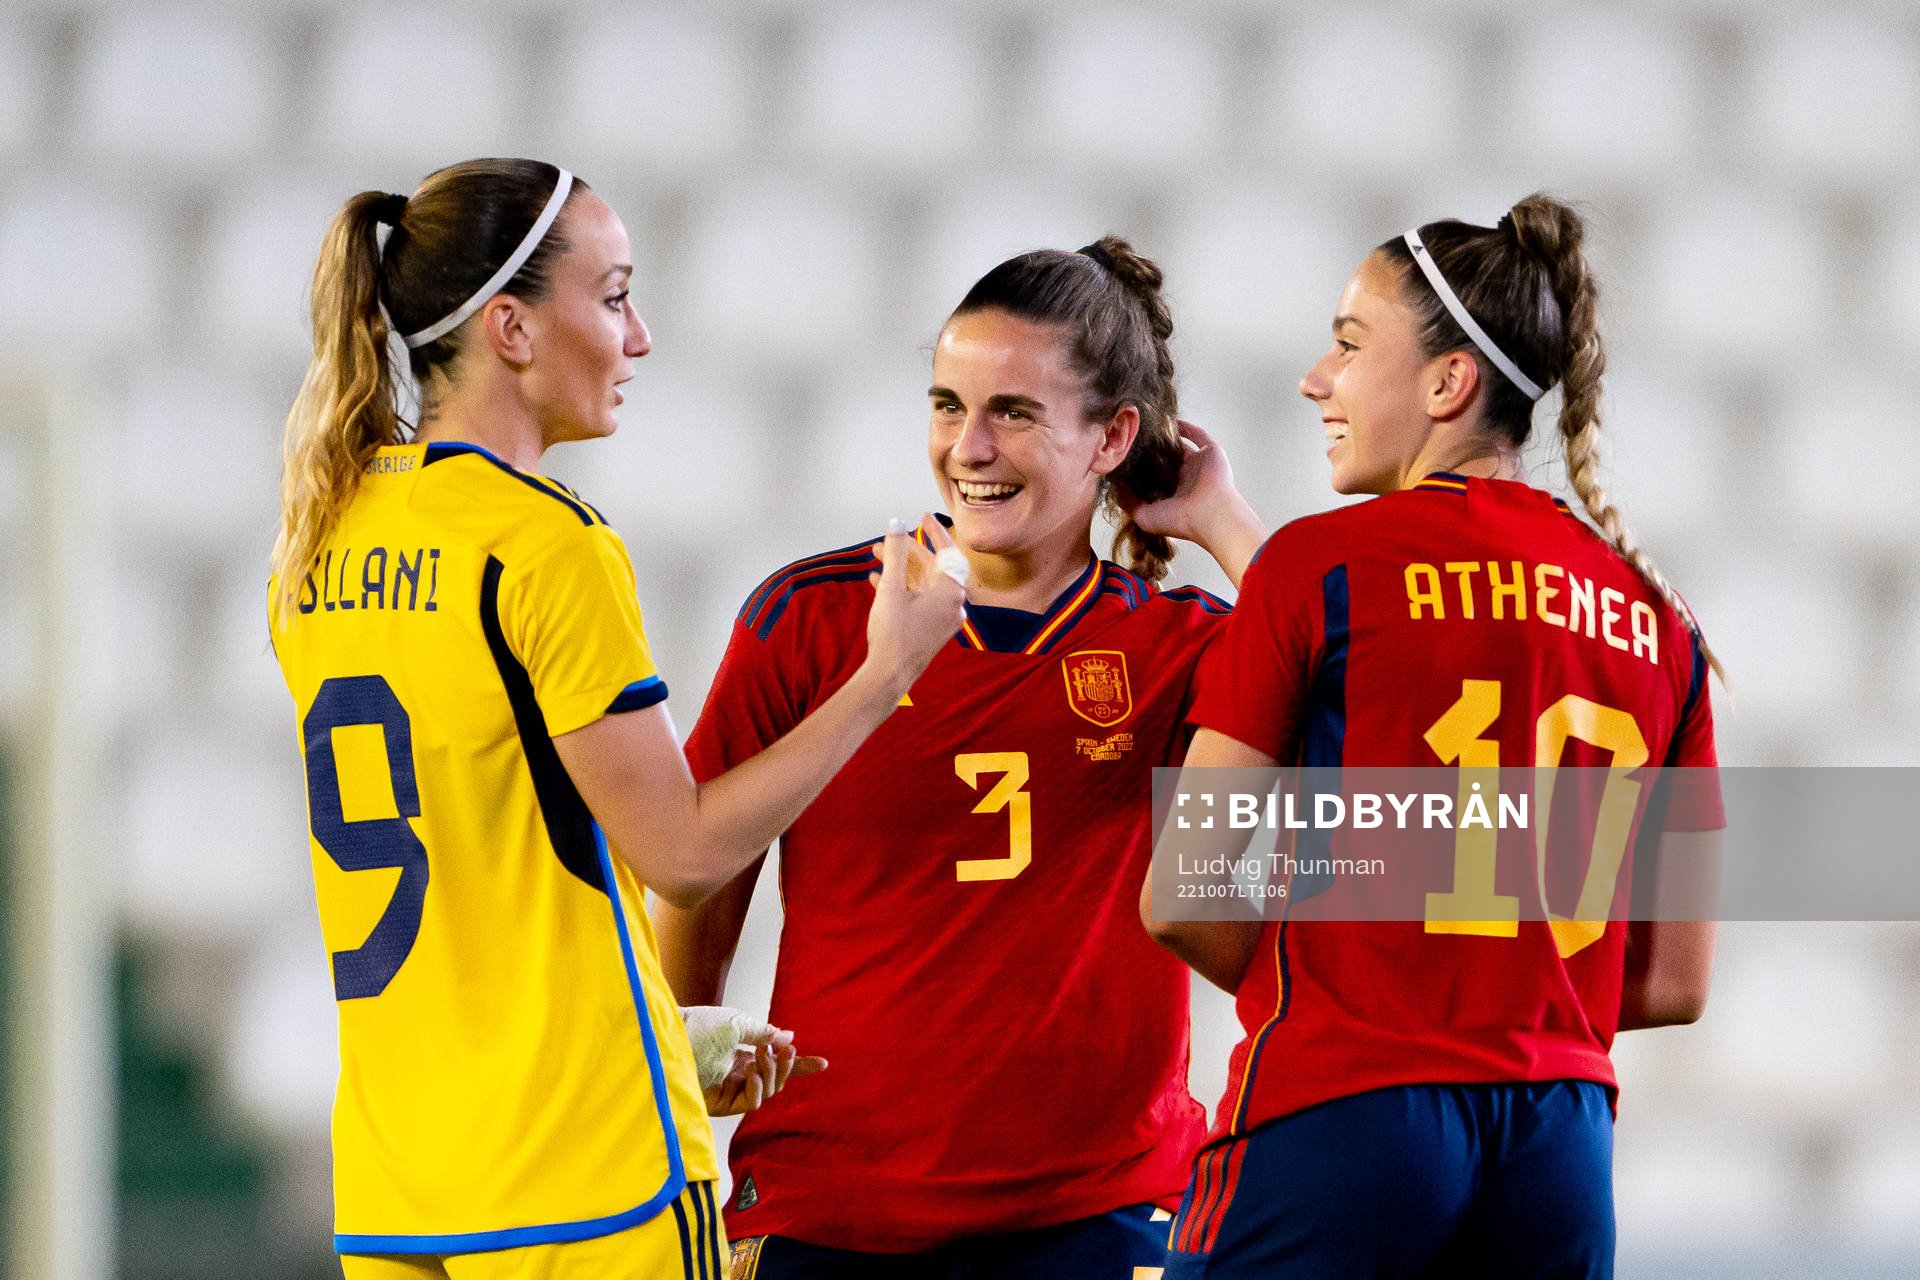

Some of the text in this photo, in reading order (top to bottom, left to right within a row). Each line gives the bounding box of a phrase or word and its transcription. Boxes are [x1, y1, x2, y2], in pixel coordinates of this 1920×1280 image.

[366, 455, 416, 475] ERIGE
[288, 546, 441, 615] SLLANI
[1404, 560, 1658, 665] ATHENEA
[1075, 746, 1081, 754] 7
[1083, 743, 1115, 755] OCTOBER
[1076, 738, 1098, 747] SPAIN
[1106, 733, 1133, 743] SWEDEN
[303, 675, 430, 1001] 9
[955, 752, 1032, 882] 3
[1423, 679, 1649, 959] 10
